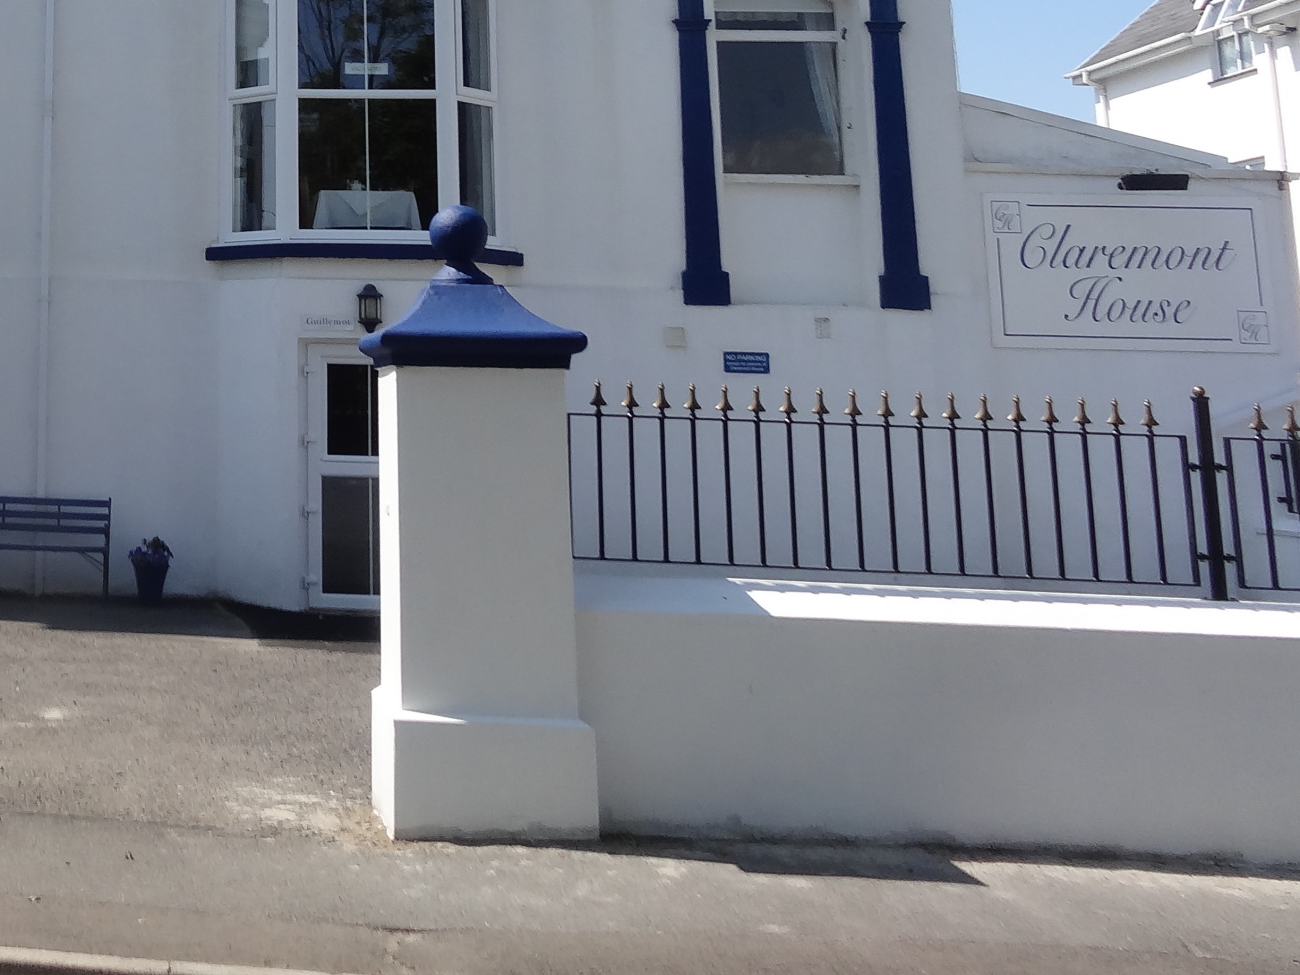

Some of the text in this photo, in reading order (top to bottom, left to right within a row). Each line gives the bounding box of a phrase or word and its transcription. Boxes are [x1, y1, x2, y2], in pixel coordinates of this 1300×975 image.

[1019, 222, 1237, 272] Claremont
[1064, 275, 1194, 325] House
[305, 316, 351, 326] Guillemot
[725, 353, 767, 362] NO PARKING
